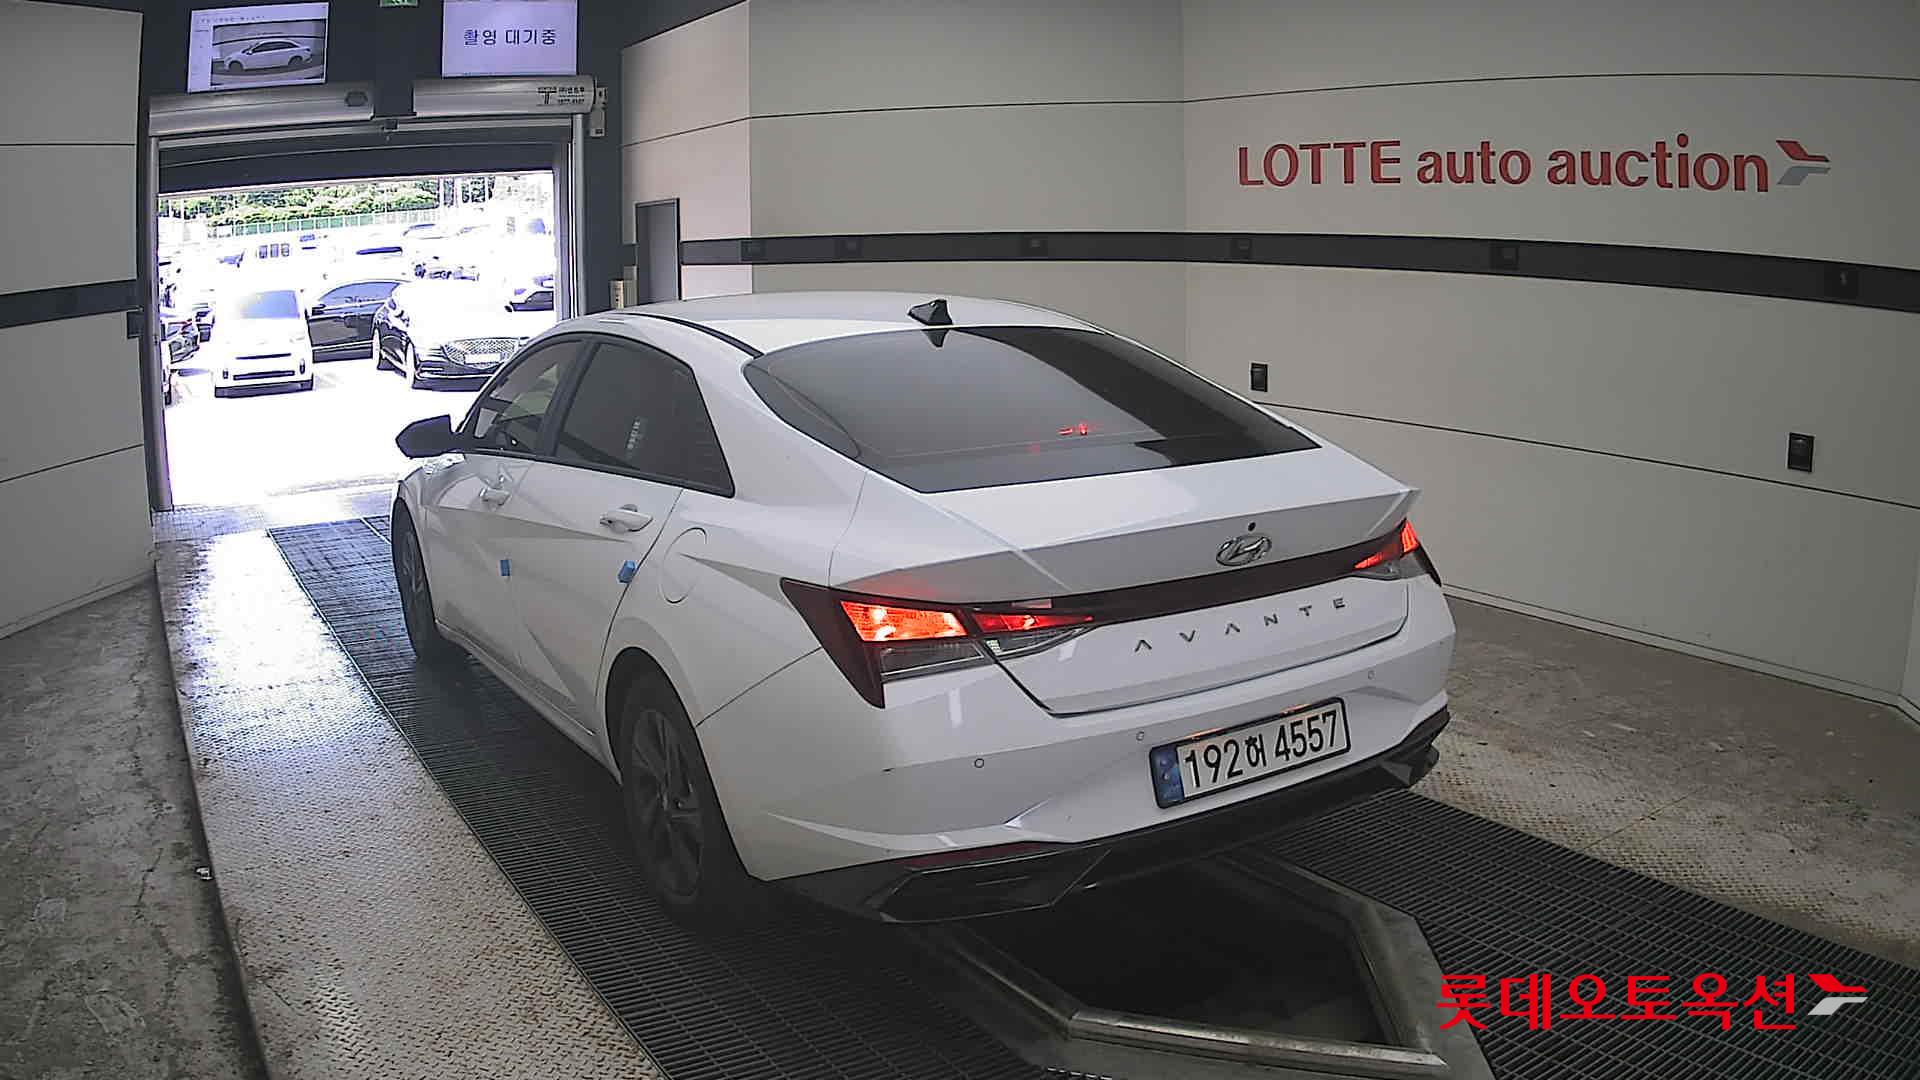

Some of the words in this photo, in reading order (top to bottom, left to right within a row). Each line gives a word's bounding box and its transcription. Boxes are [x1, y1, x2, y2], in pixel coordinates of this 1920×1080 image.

[463, 29, 497, 46] 촬영
[505, 29, 556, 46] 대기중
[1238, 140, 1401, 187] LOTTE
[1416, 140, 1532, 186] auto
[1546, 132, 1769, 192] auction
[1134, 597, 1346, 653] AVANTE
[1274, 709, 1338, 763] 4557
